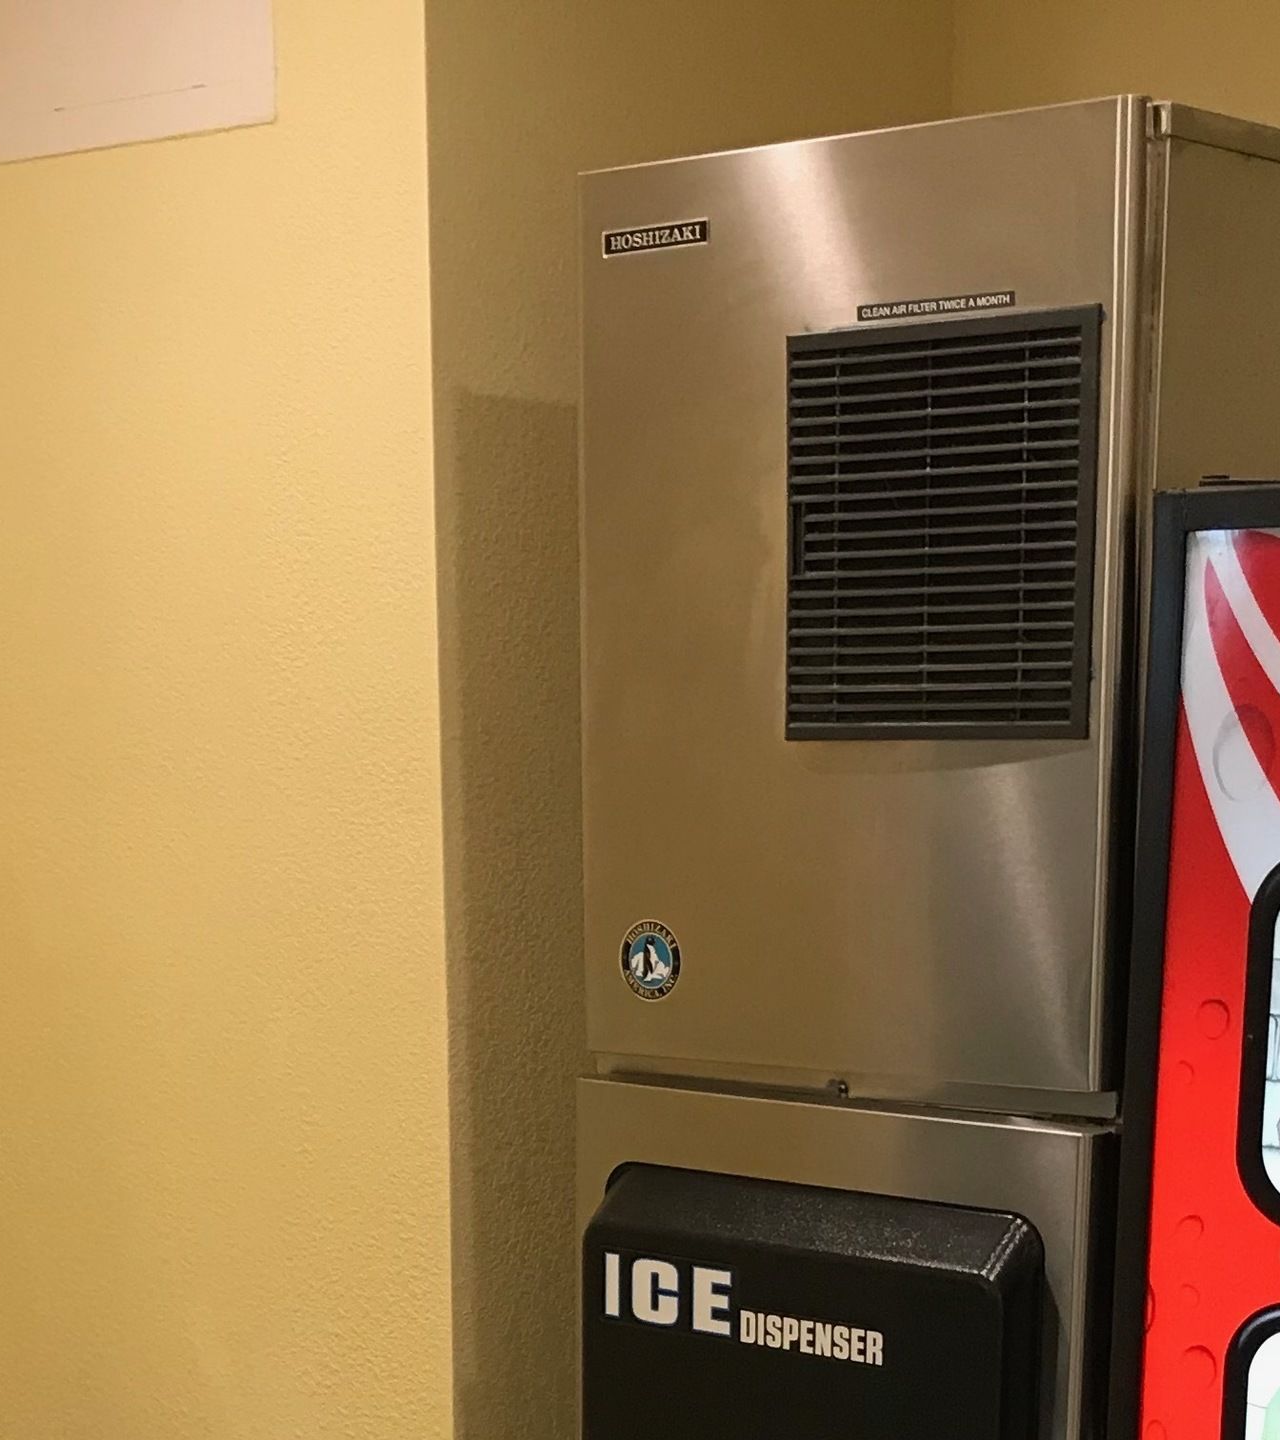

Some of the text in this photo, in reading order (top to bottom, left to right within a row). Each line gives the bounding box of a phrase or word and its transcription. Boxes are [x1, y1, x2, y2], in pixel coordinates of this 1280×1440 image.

[609, 225, 701, 251] HOSHIZAKI
[861, 294, 1011, 319] CLEAN AIR FILTER TWICE A MONTH
[605, 1252, 884, 1366] ICE DISPENSER
